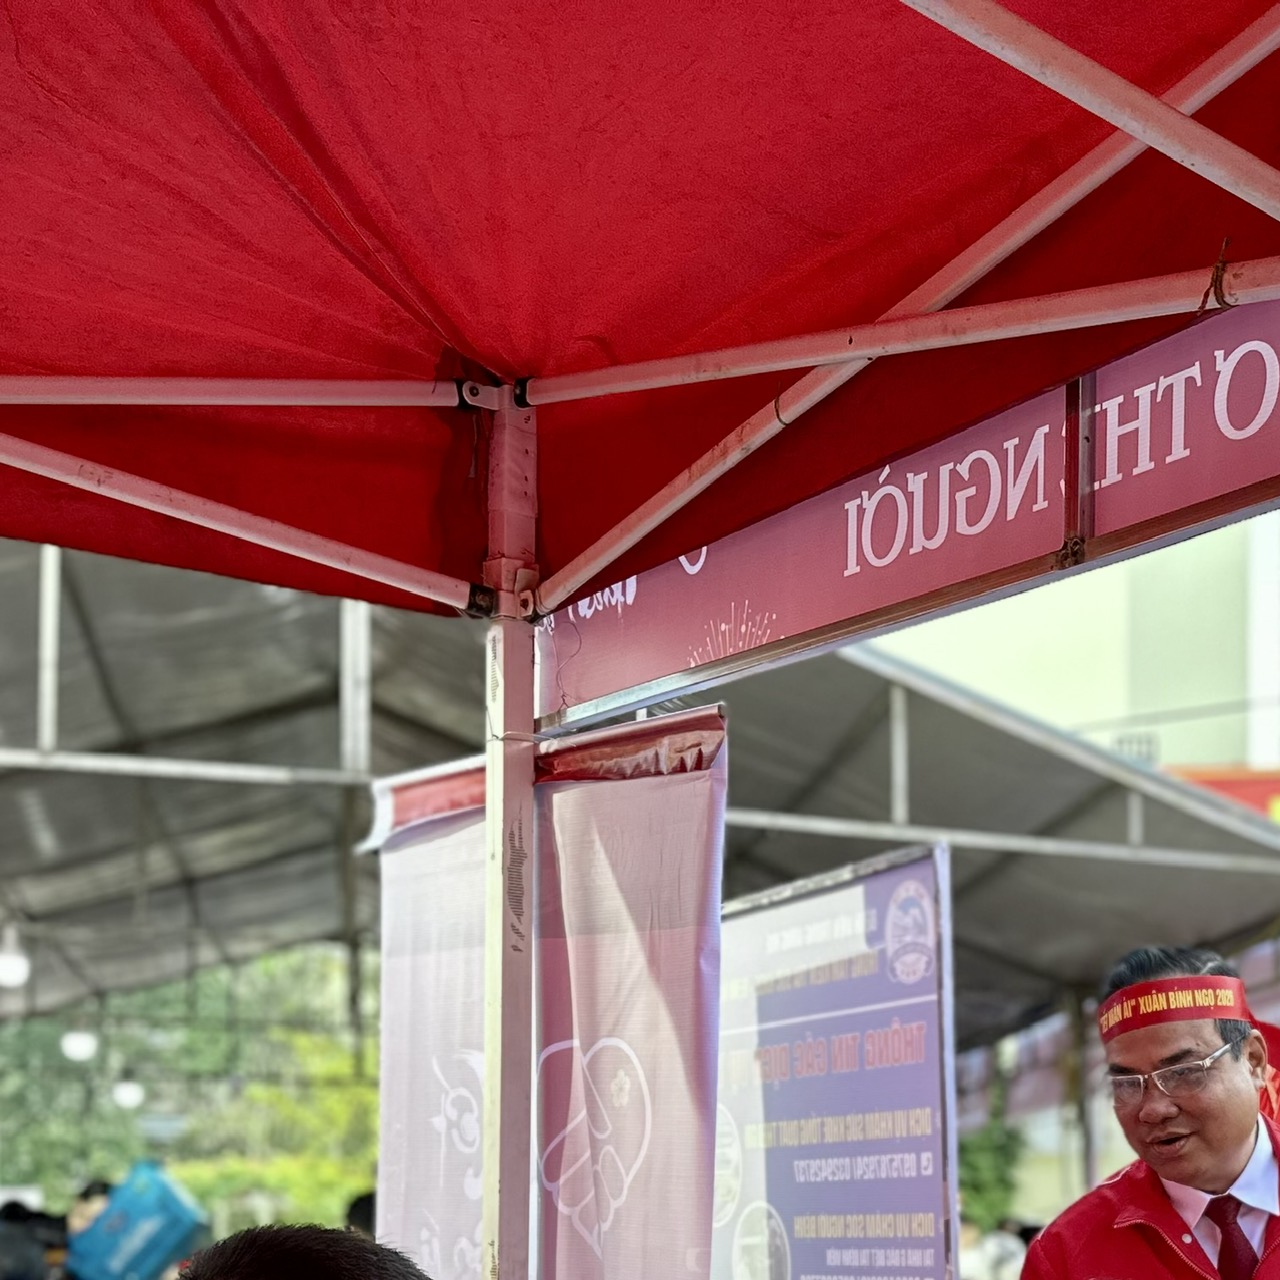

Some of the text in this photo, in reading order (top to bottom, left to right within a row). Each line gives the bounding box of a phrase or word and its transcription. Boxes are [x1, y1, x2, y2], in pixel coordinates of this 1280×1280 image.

[1138, 990, 1167, 1014] XUÂN
[1169, 986, 1194, 1009] BÍNH
[1195, 989, 1216, 1010] NGỌ
[1216, 988, 1235, 1007] 2026
